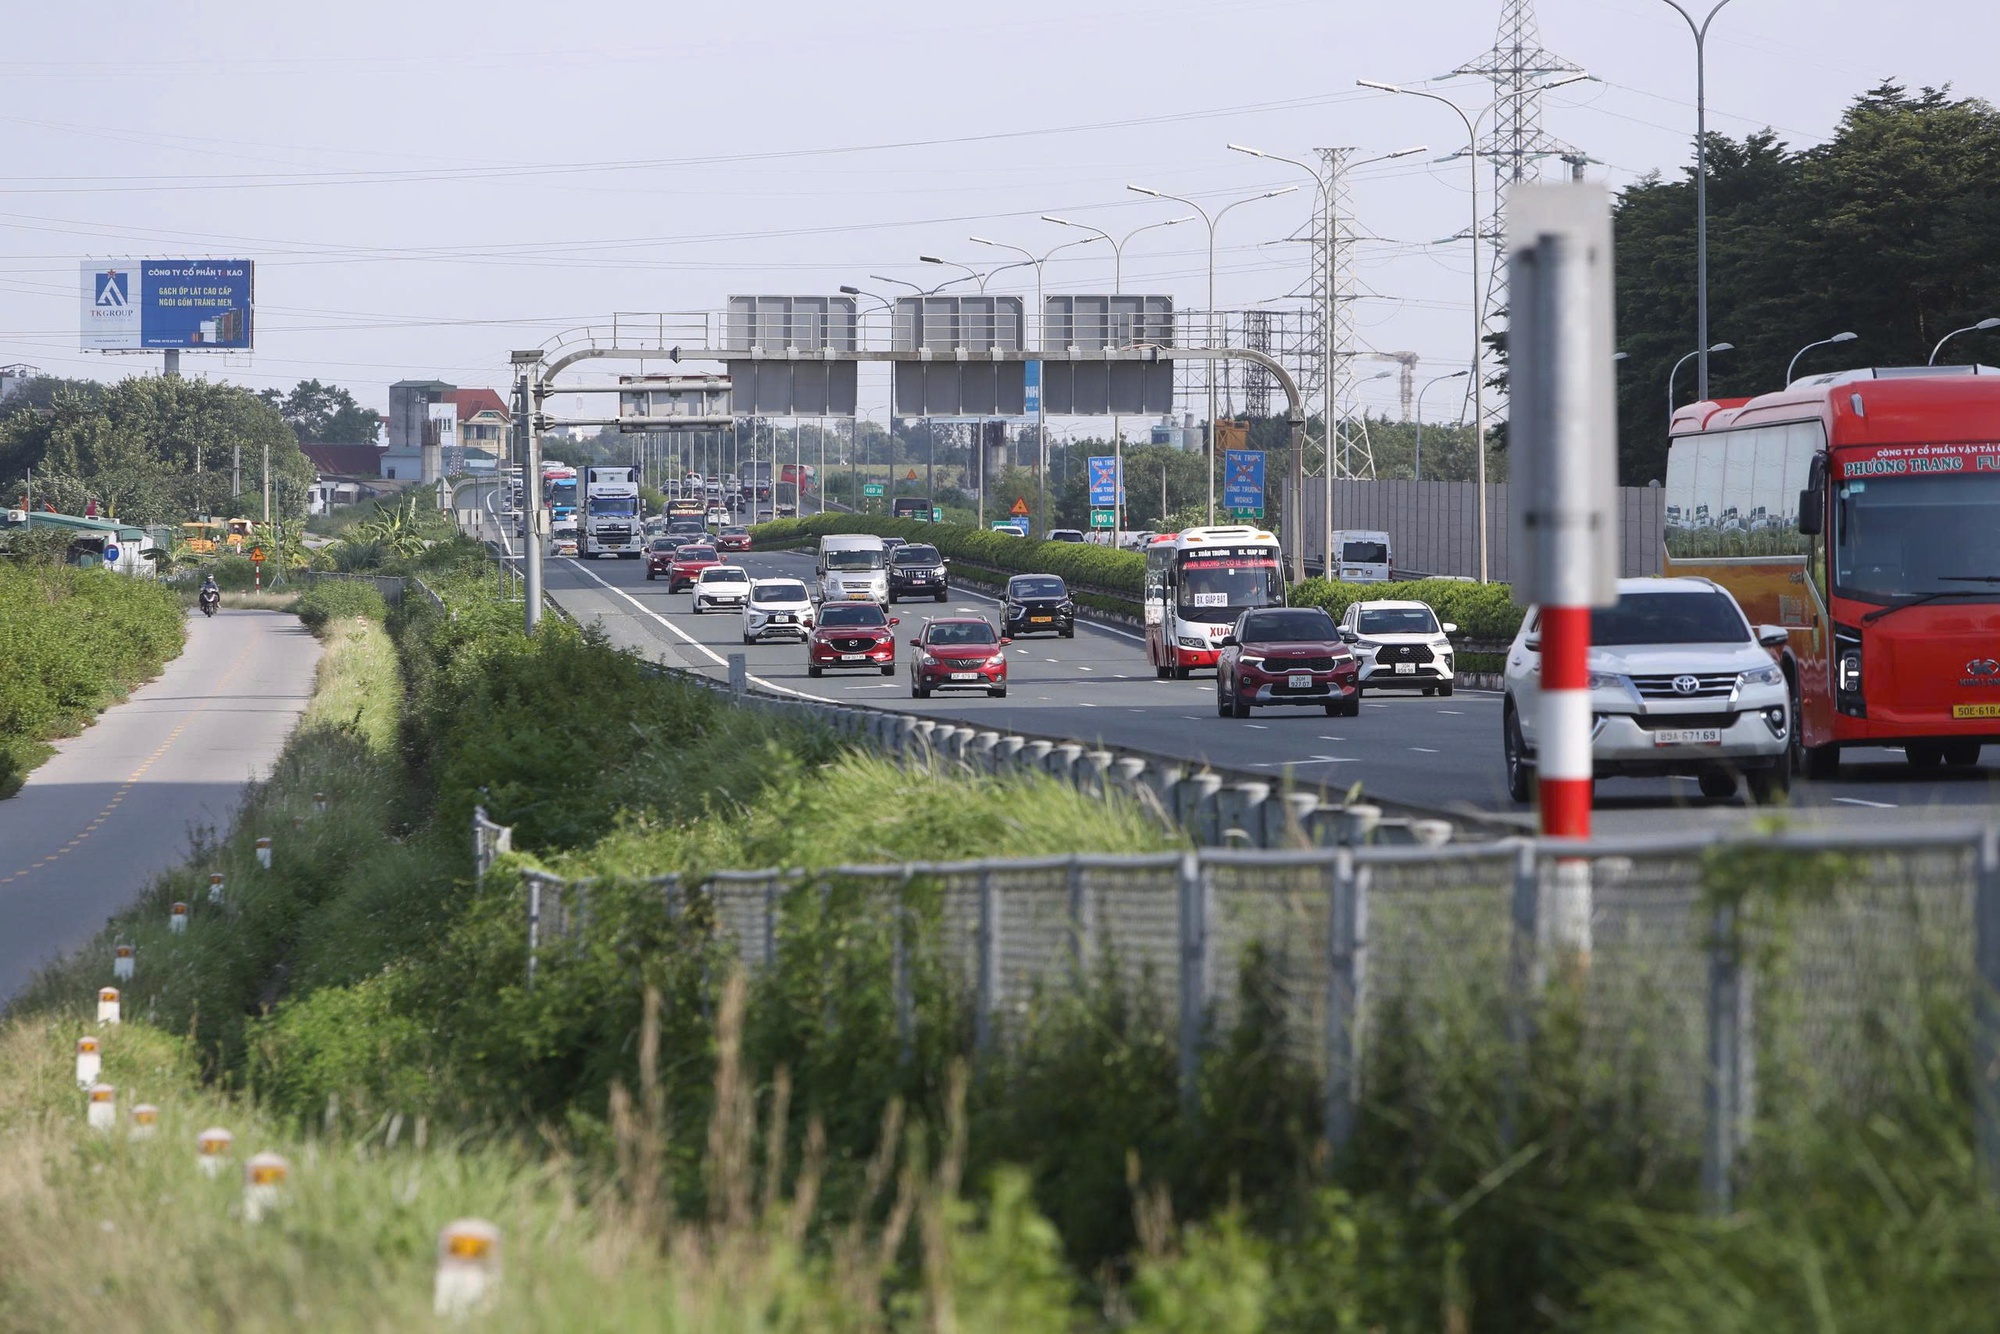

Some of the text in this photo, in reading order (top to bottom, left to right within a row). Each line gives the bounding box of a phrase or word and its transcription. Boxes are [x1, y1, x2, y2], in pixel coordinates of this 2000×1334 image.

[148, 268, 170, 276] CÔNG
[203, 287, 217, 295] CAO
[1877, 448, 1901, 457] CÔNG
[1918, 445, 1929, 454] CỔ
[1959, 444, 1977, 454] VẬN
[1979, 444, 1996, 452] TẢI
[1844, 457, 1907, 477] PHƯƠNG
[1911, 457, 1963, 472] TRANG
